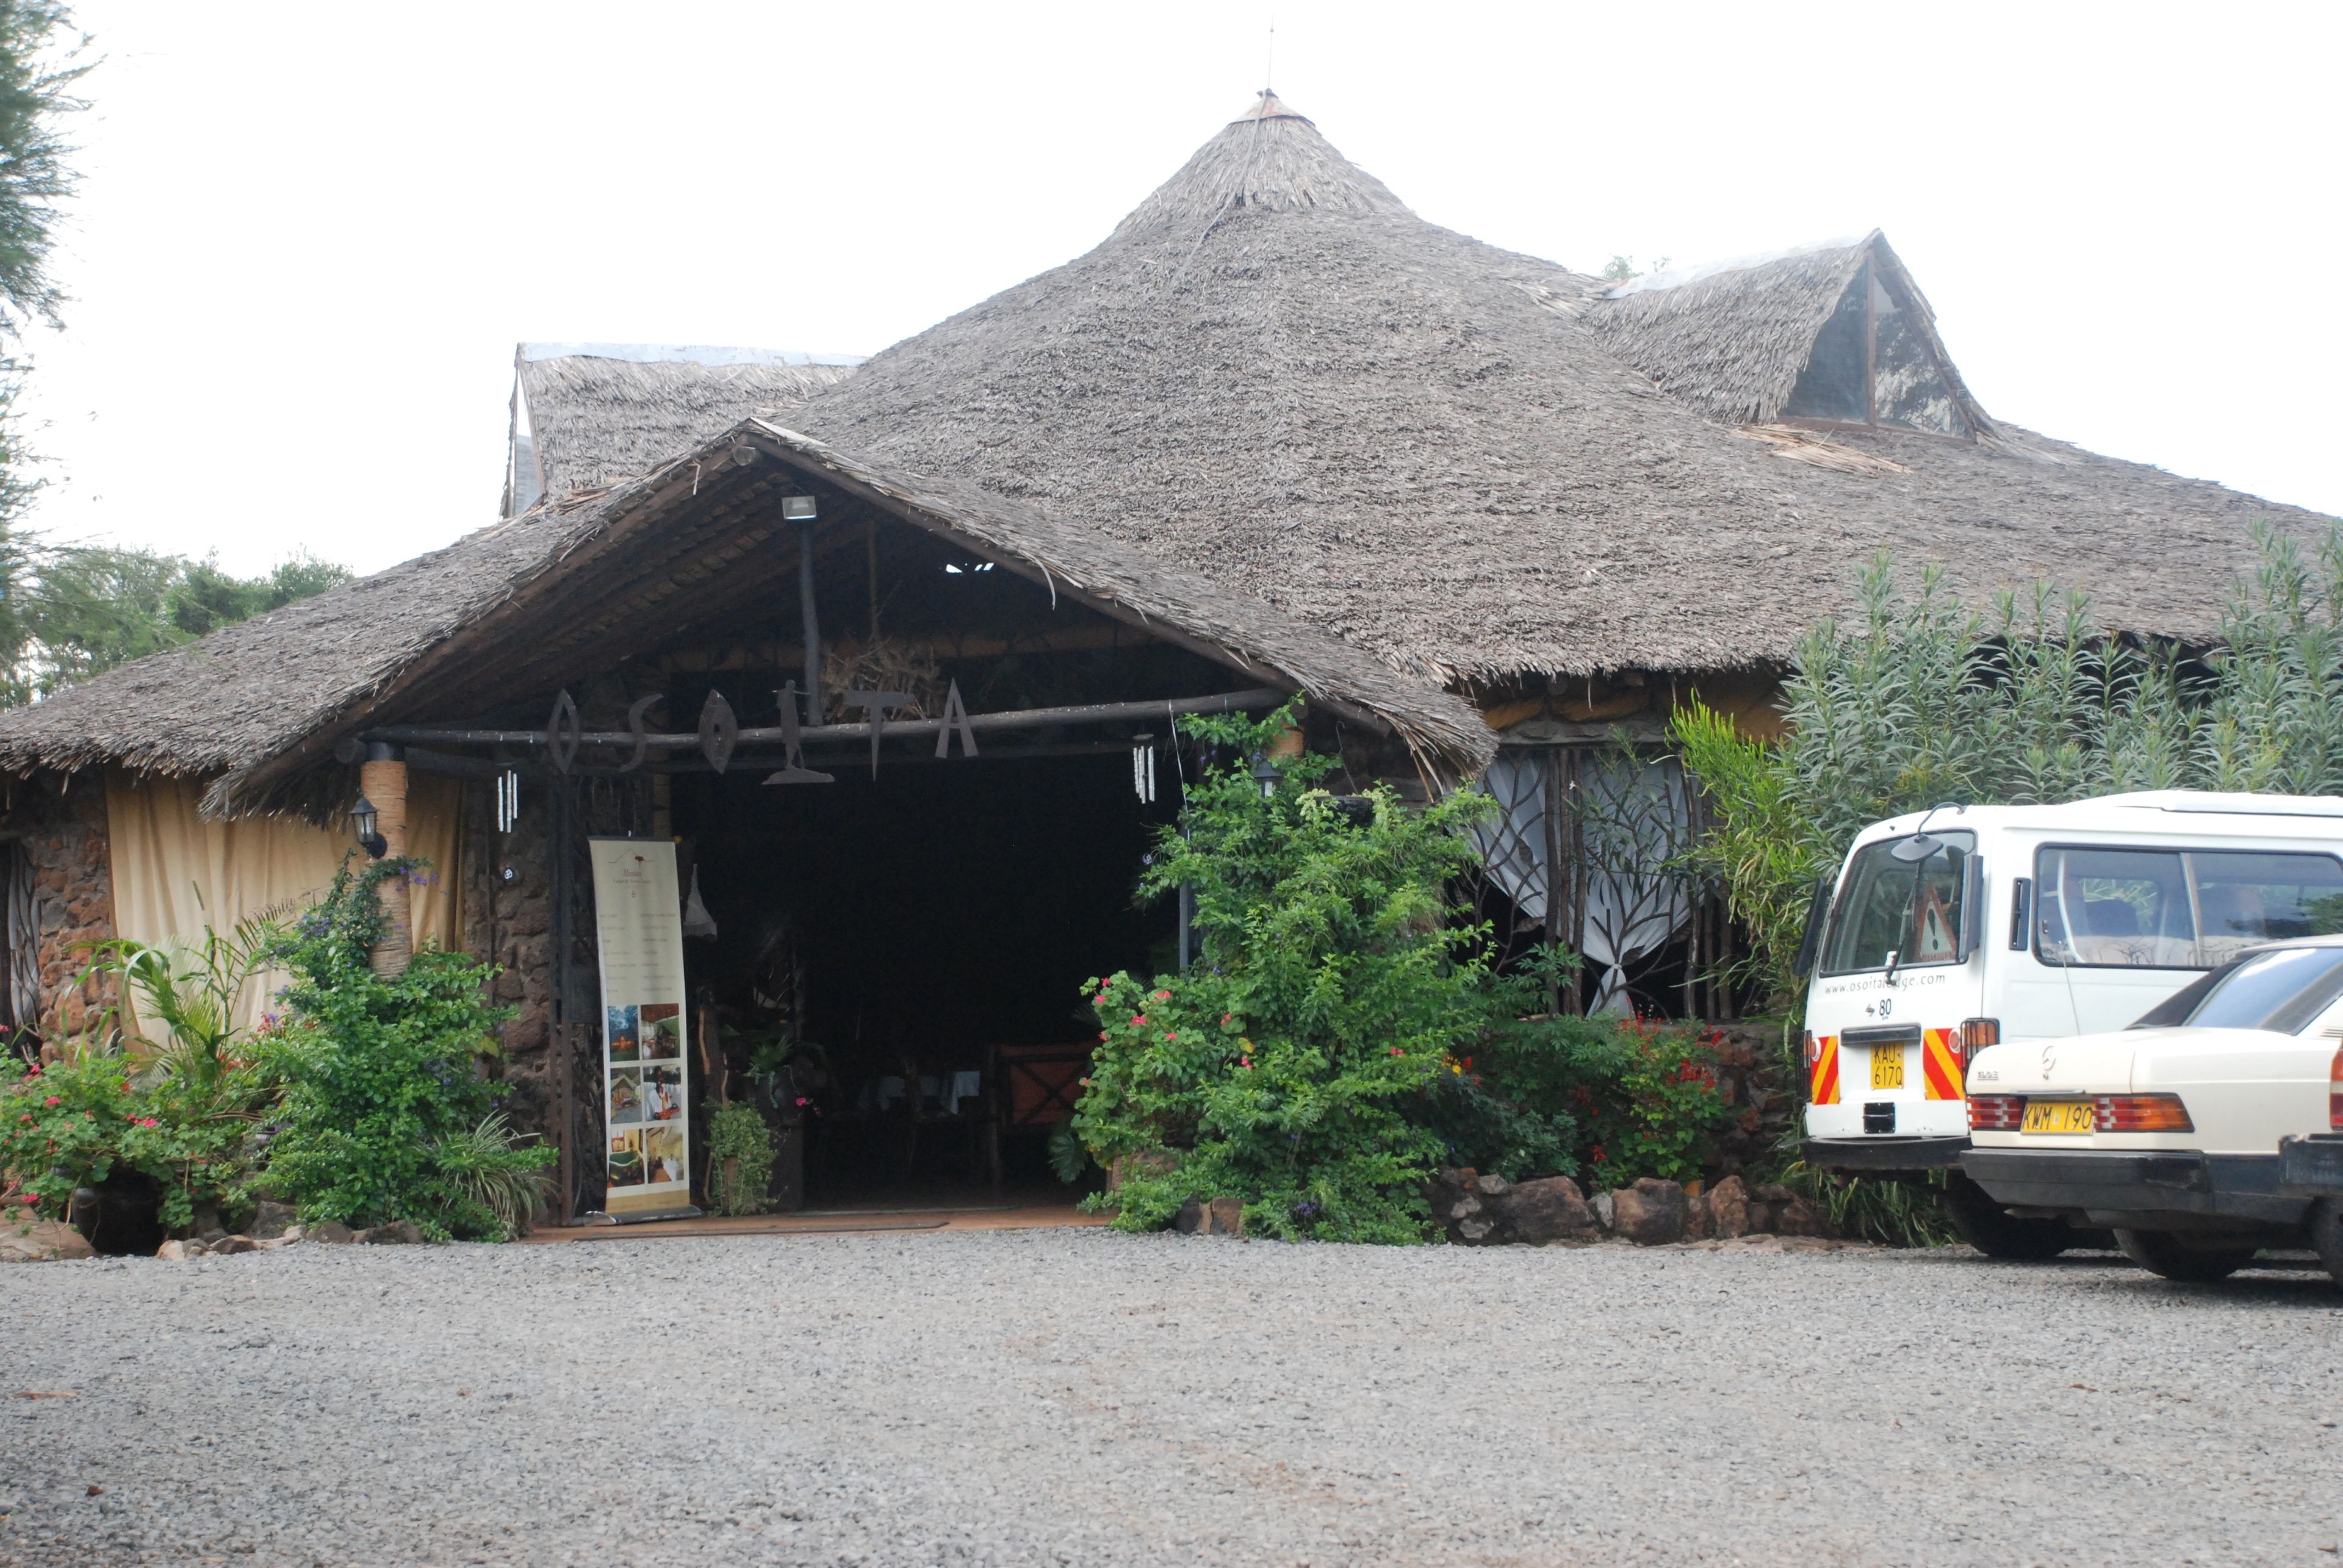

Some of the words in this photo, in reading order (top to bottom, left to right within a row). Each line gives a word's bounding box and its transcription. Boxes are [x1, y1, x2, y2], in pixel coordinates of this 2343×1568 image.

[1879, 998, 1891, 1016] 80
[1874, 1044, 1896, 1063] KAU
[1874, 1065, 1902, 1086] 617Q
[2021, 1106, 2053, 1130] KWM
[2064, 1105, 2093, 1129] 190
